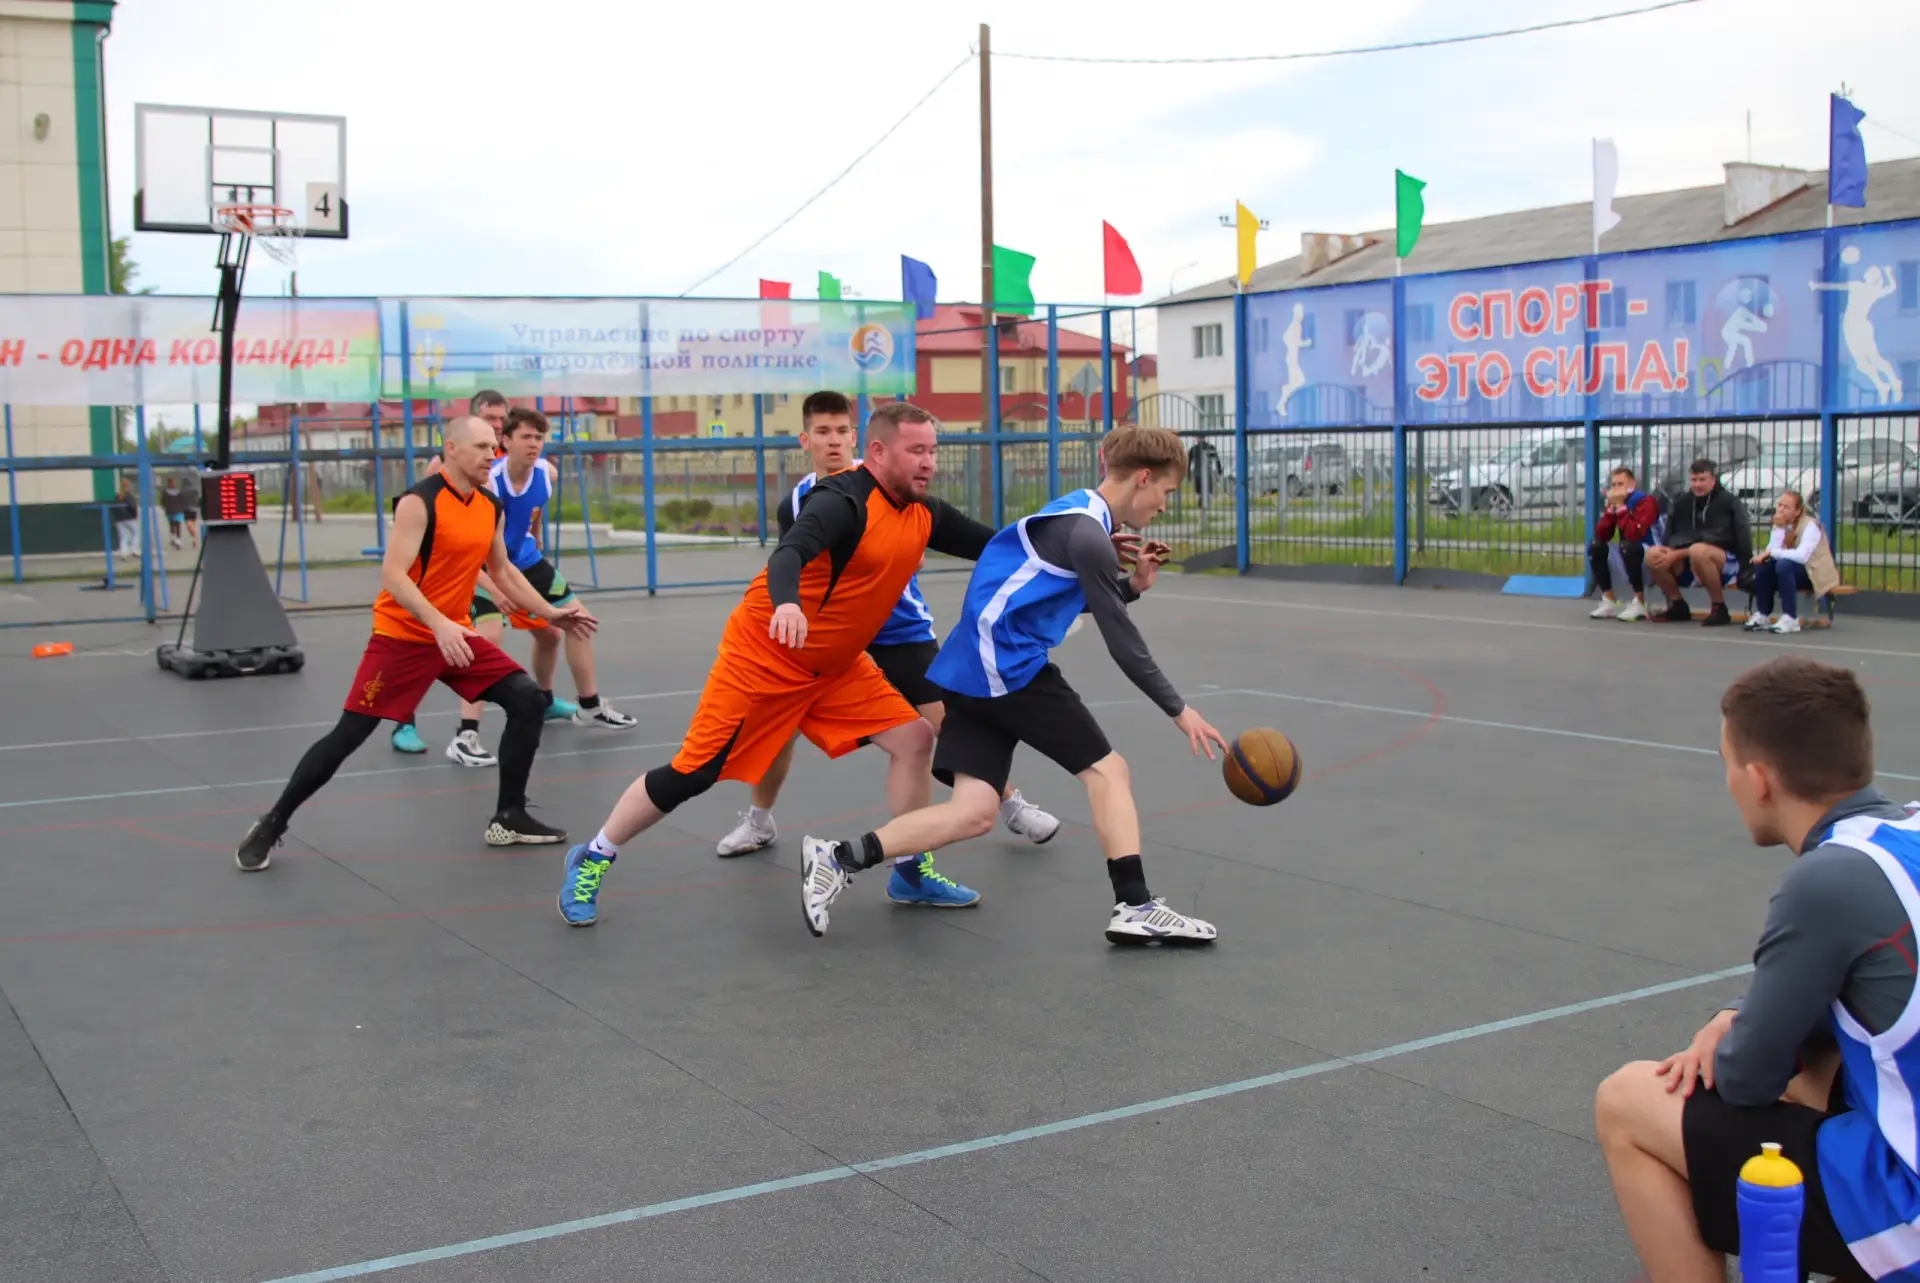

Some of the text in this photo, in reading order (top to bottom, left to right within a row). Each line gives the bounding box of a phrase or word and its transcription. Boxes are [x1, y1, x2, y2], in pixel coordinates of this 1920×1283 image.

[314, 191, 332, 218] 4
[1449, 280, 1648, 341] СПОРТ -
[512, 324, 805, 348] Управление по спорту
[60, 338, 157, 371] ОДНА
[702, 355, 819, 369] политике
[1416, 338, 1689, 401] ЭТО СИЛА!
